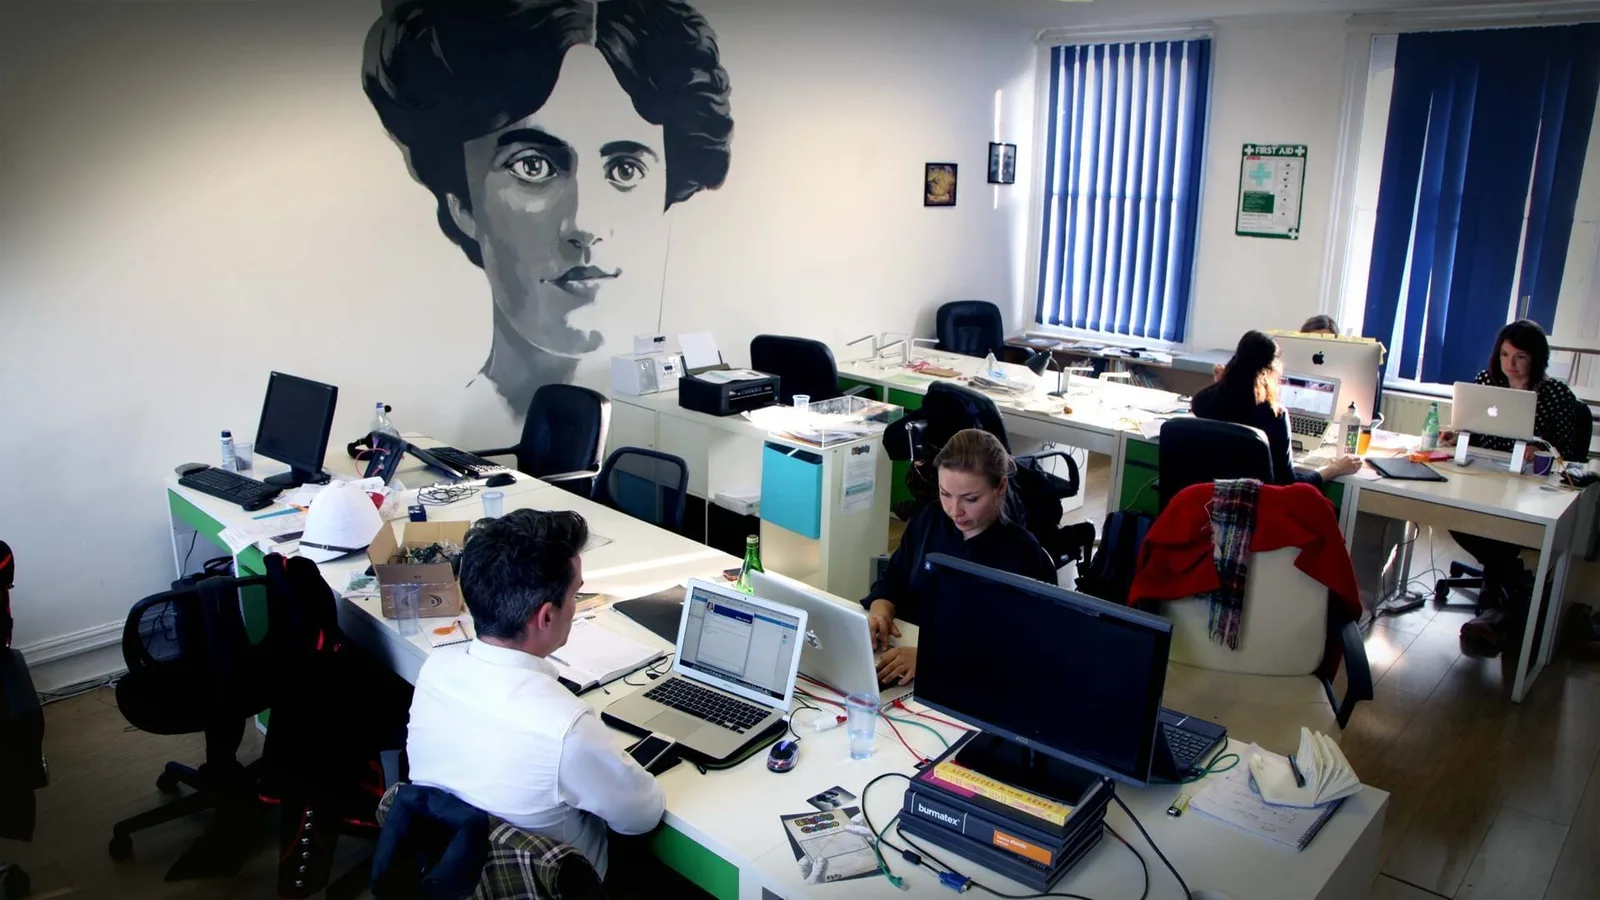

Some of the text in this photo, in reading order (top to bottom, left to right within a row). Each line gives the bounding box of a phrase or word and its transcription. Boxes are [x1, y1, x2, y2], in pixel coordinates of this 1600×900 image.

[1255, 146, 1294, 155] FIRST AID
[918, 803, 958, 826] burmatex
